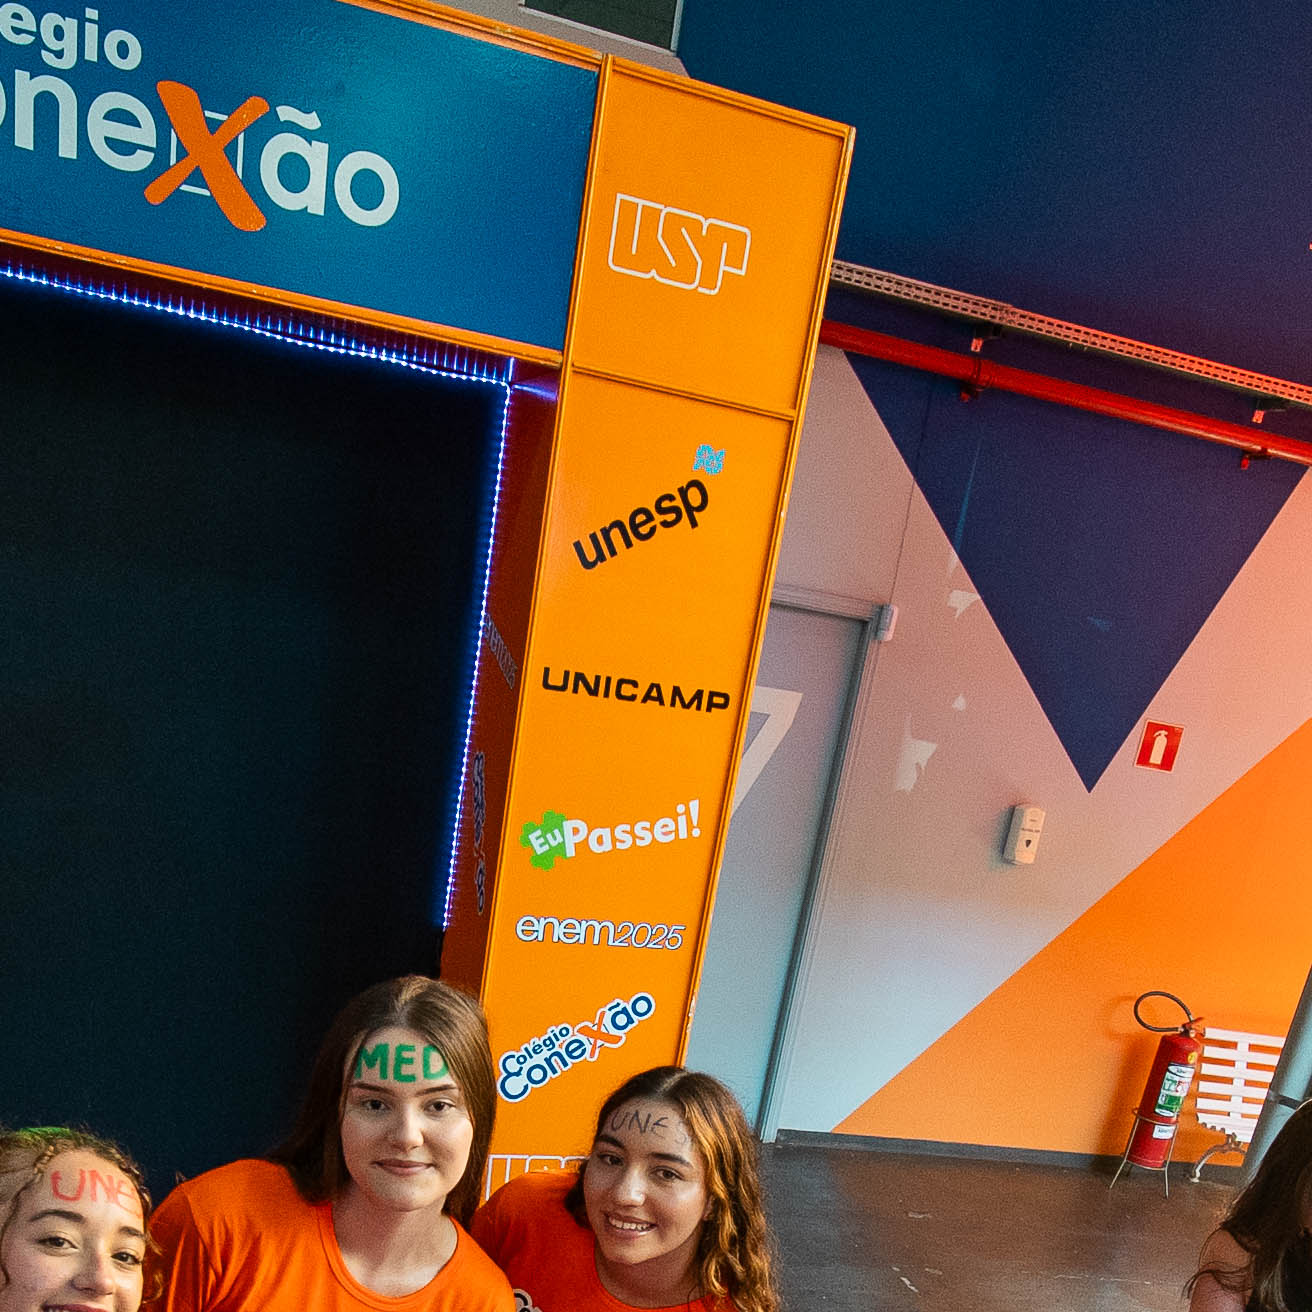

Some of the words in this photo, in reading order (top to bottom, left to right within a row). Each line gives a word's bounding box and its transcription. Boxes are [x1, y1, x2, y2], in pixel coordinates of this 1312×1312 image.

[608, 193, 751, 295] USP
[573, 478, 709, 570] unesp
[541, 666, 731, 714] UNICAMP
[529, 828, 564, 857] Eu
[562, 800, 701, 858] Passei!
[516, 915, 686, 950] enem2025
[356, 1043, 451, 1083] MED
[501, 1025, 571, 1077] Colégio
